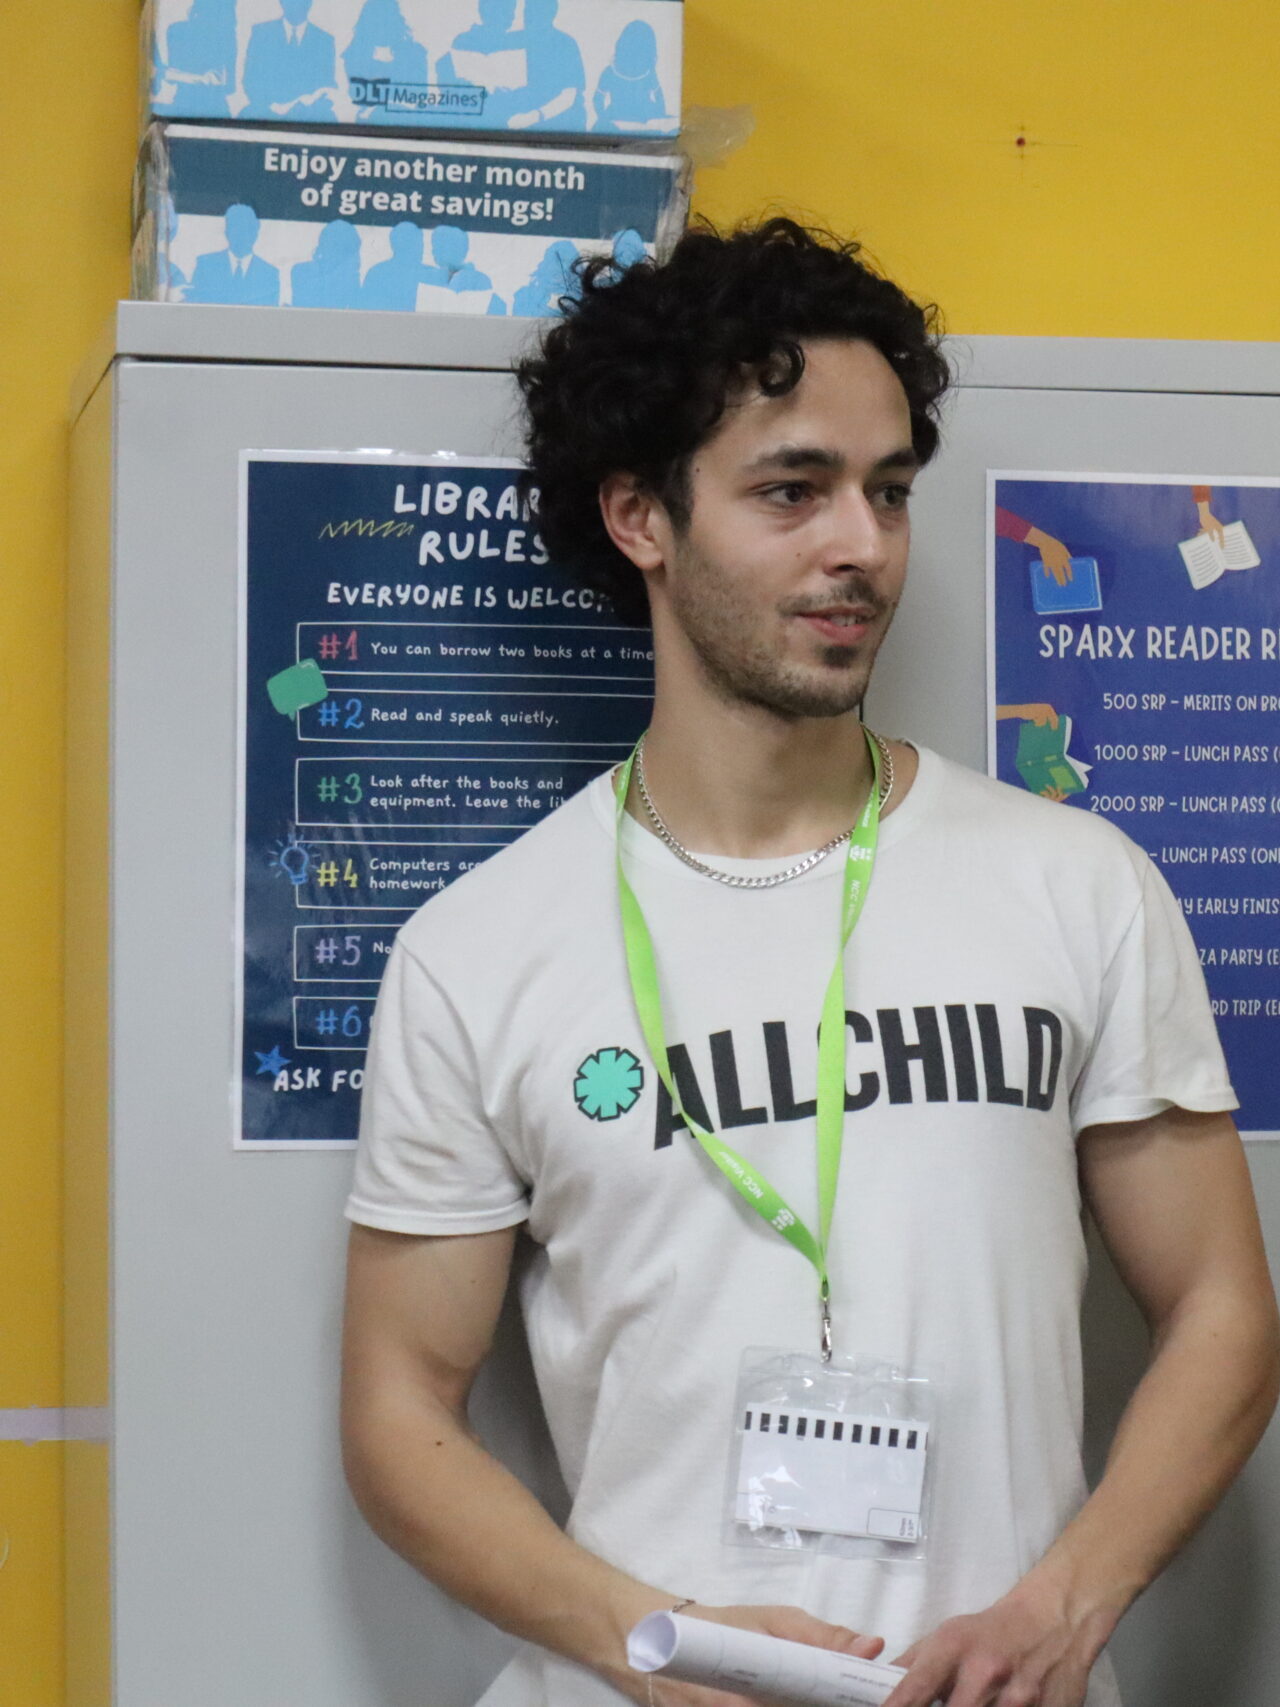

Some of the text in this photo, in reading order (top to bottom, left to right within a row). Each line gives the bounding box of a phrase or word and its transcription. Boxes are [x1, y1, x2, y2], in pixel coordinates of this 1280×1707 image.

[349, 77, 390, 106] DLT
[263, 147, 586, 192] Enjoy another month
[300, 183, 555, 226] of great savings!
[418, 529, 549, 566] RULES
[327, 582, 615, 613] EVERYONE IS WELCO
[317, 629, 359, 661] #1
[370, 641, 398, 657] You
[405, 645, 432, 657] can
[439, 643, 491, 658] borrow
[499, 645, 526, 658] two
[534, 646, 573, 659] books
[580, 647, 596, 659] at
[603, 650, 613, 659] a
[1039, 624, 1136, 660] SPARX
[1146, 625, 1252, 662] READER
[317, 698, 560, 729] #2 Read and speak quietly.
[1102, 693, 1138, 711] 500
[1141, 694, 1167, 711] SRP
[1183, 694, 1232, 712] MERITS
[1236, 695, 1258, 712] ON
[1093, 744, 1139, 762] 1000
[1142, 744, 1168, 762] SRP
[1184, 745, 1230, 763] LUNCH
[1234, 746, 1269, 763] PASS
[316, 772, 364, 805] #3
[369, 774, 564, 790] Look after the books and
[369, 794, 456, 811] equipment.
[465, 794, 509, 809] Leave
[516, 794, 542, 809] the
[1090, 795, 1137, 813] 2000
[1140, 796, 1166, 813] SRP
[1182, 796, 1228, 814] LUNCH
[1231, 796, 1267, 814] PASS
[369, 857, 451, 875] Computers
[1161, 847, 1208, 864] LUNCH
[1211, 847, 1247, 864] PASS
[315, 858, 359, 889] #4
[369, 875, 446, 890] homework
[1197, 897, 1239, 915] EARLY
[314, 935, 362, 966] #5
[1220, 948, 1263, 966] PARTY
[314, 1004, 362, 1038] #6
[1232, 999, 1261, 1016] TRIP
[273, 1066, 365, 1093] ASK FO
[653, 1003, 1063, 1151] ALLCHILD
